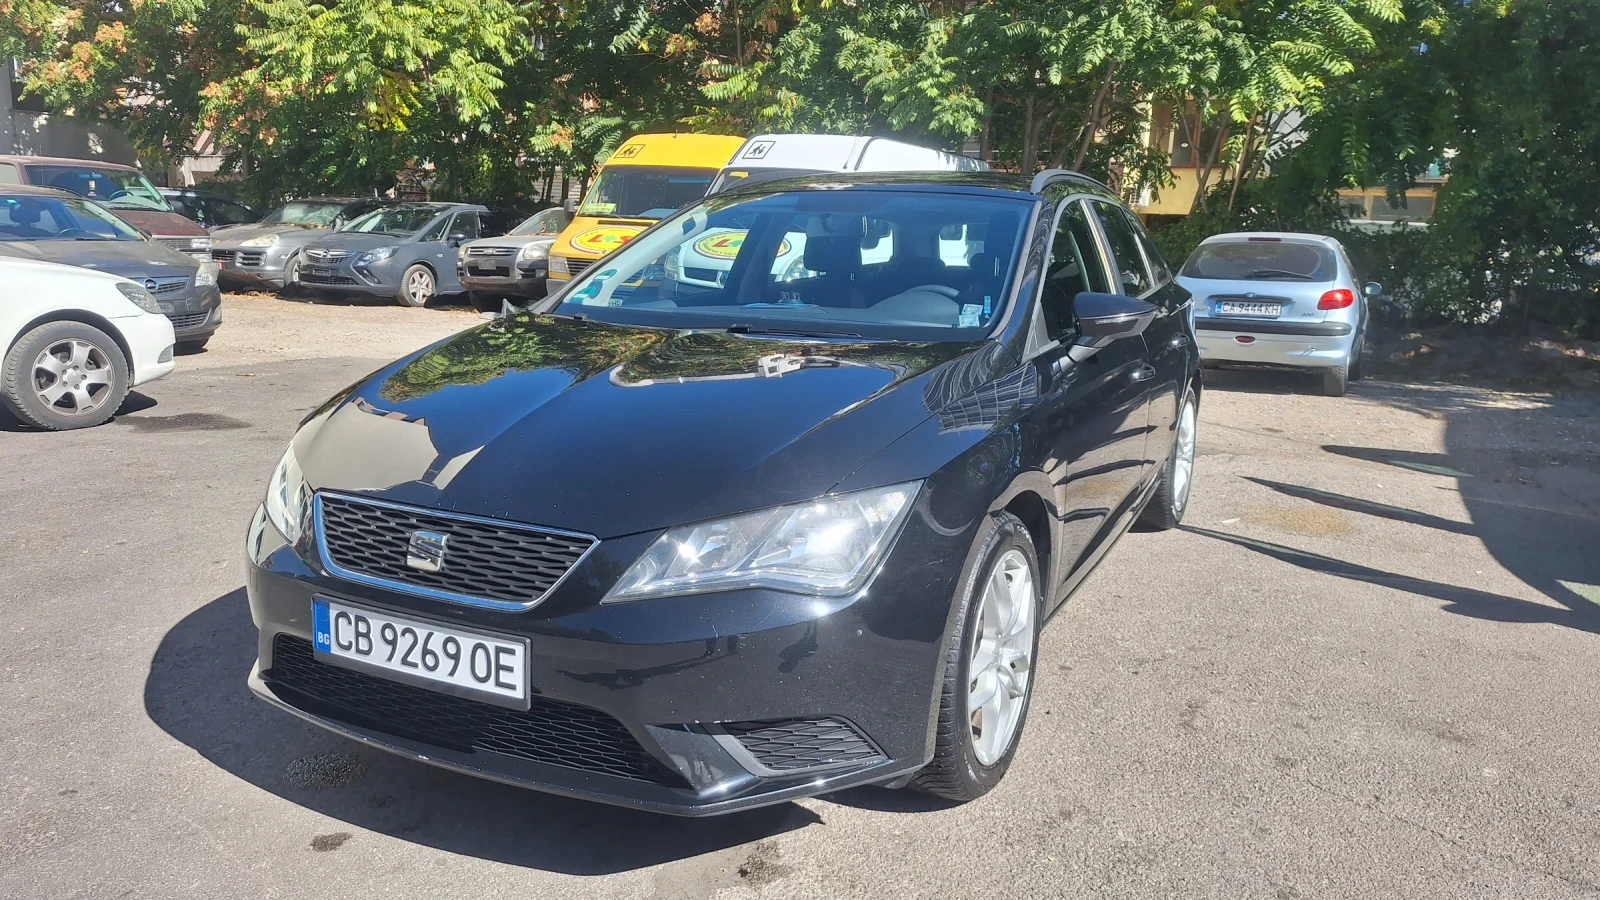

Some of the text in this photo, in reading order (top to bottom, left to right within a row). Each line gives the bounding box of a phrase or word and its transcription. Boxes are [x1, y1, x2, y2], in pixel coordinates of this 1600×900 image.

[1222, 303, 1279, 314] CA 9444 KH
[317, 631, 330, 645] BG
[334, 611, 517, 691] CB 9269 OE
